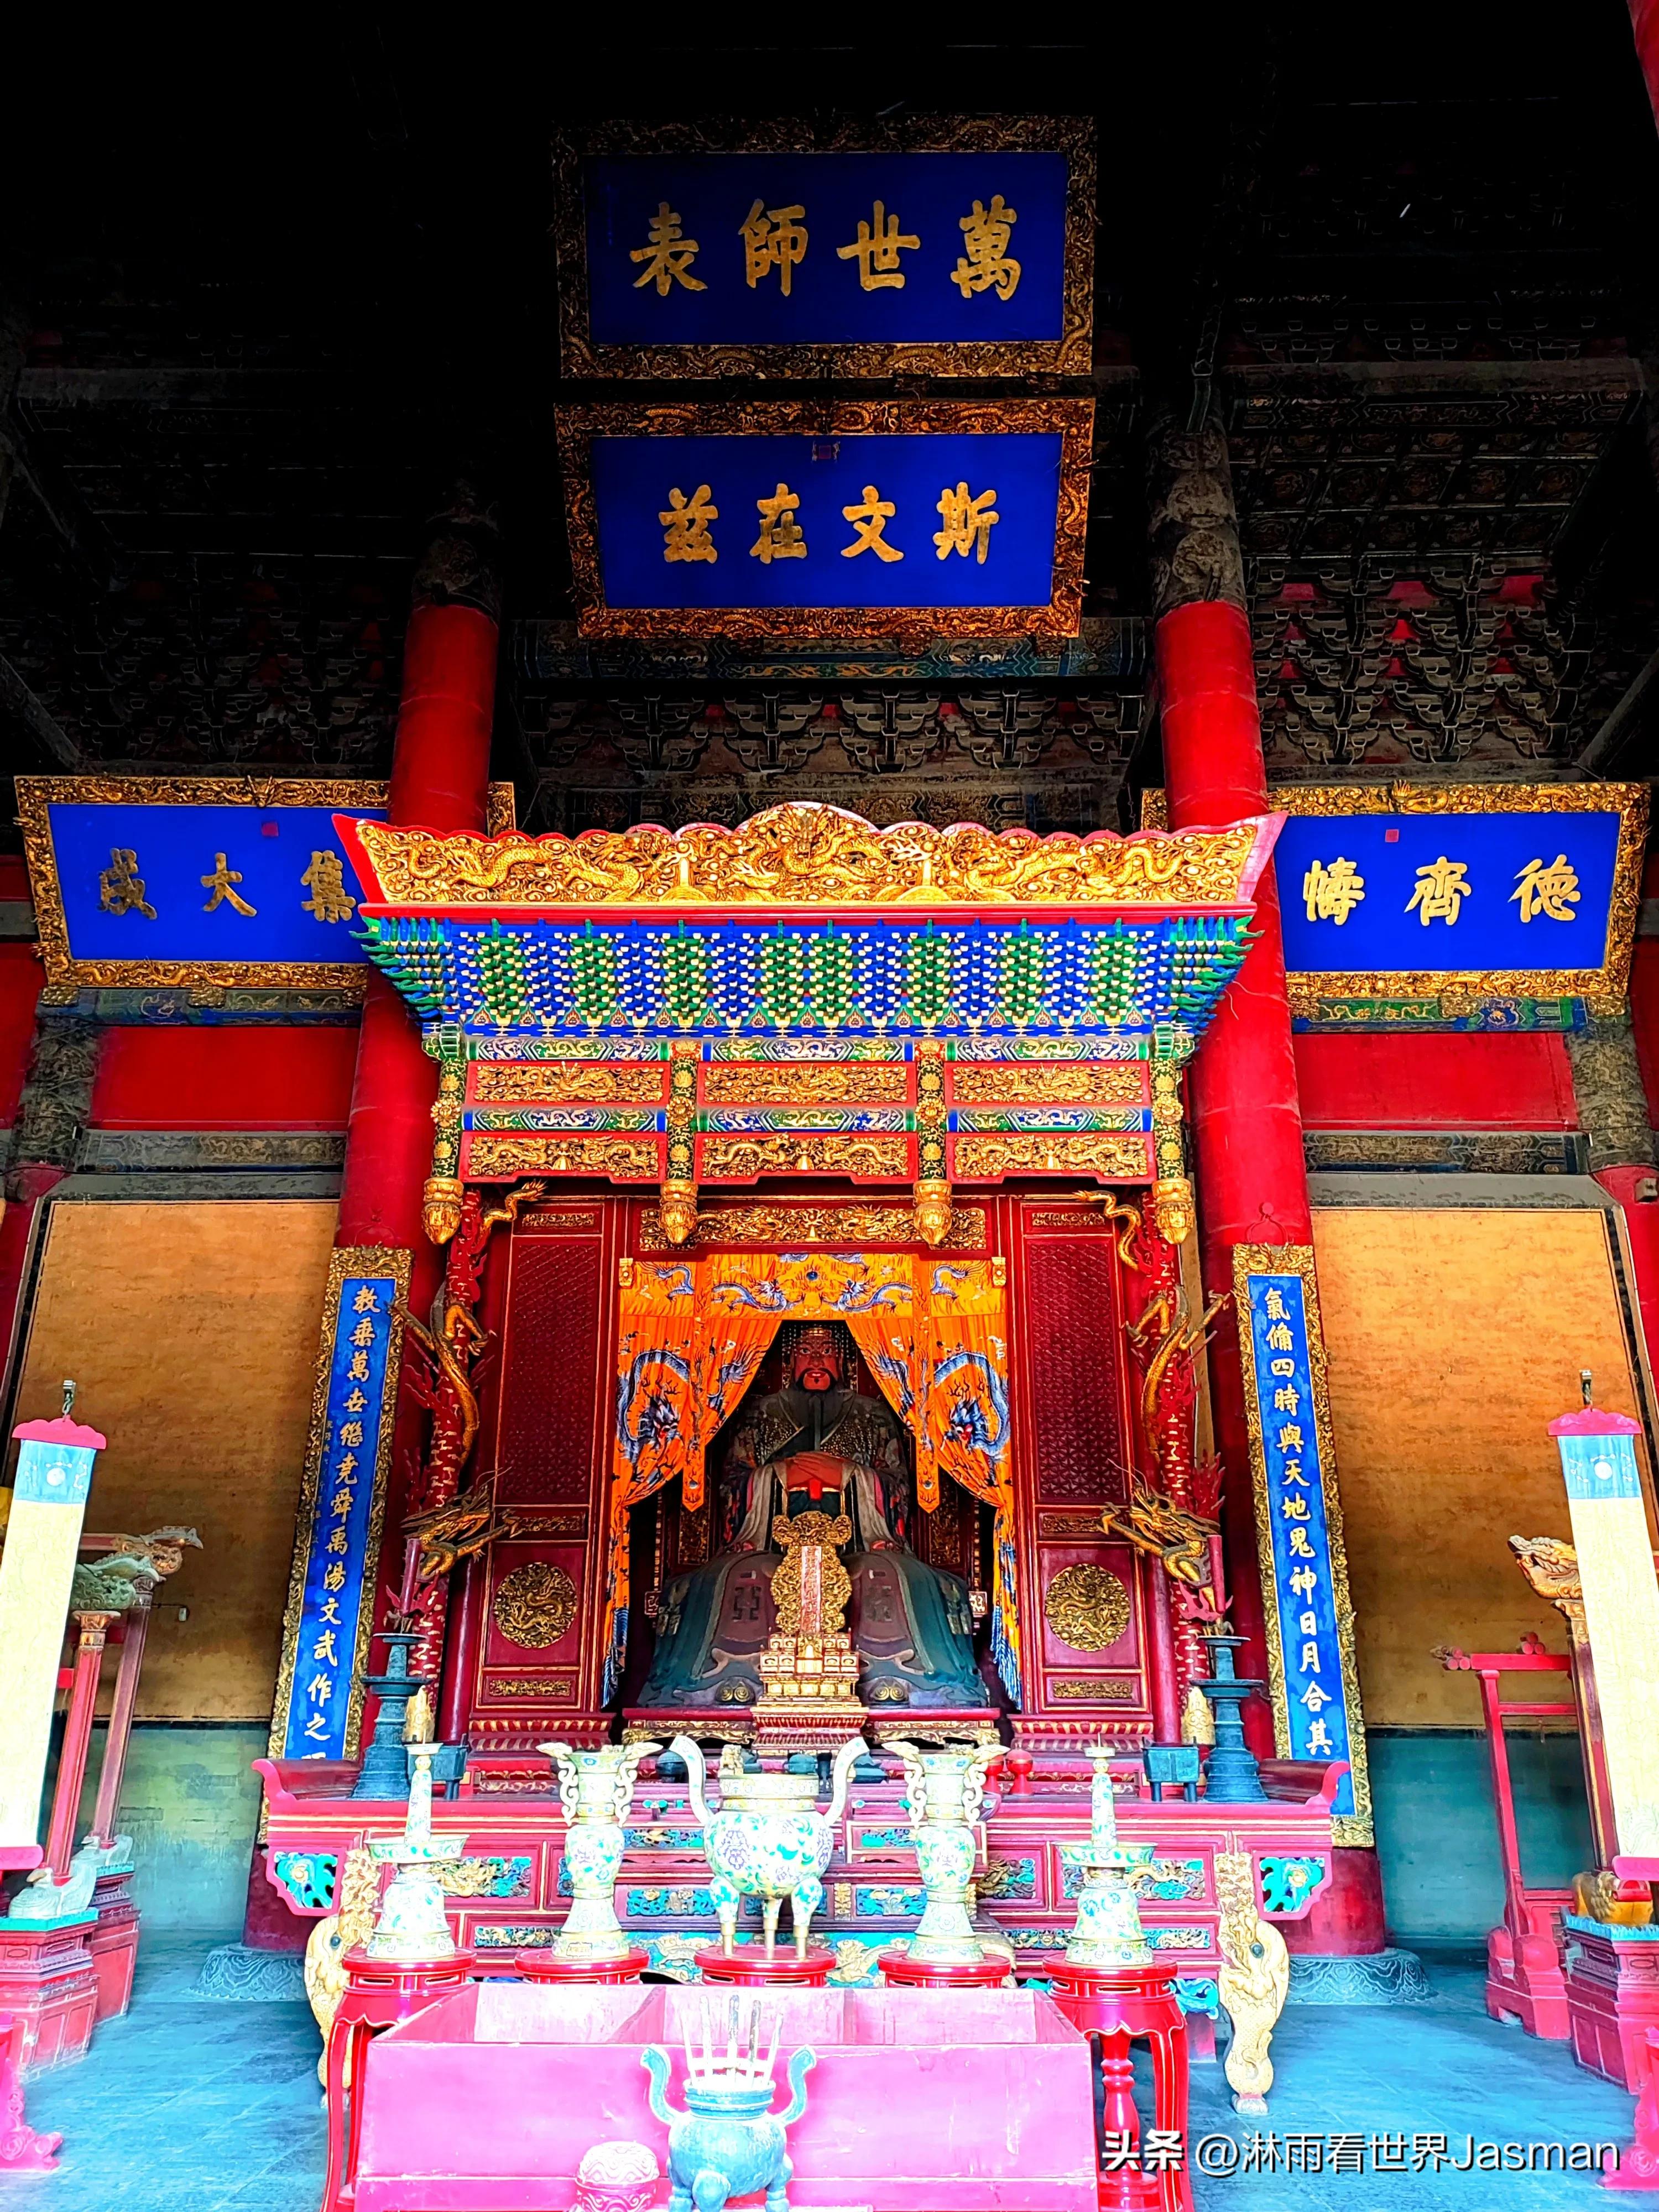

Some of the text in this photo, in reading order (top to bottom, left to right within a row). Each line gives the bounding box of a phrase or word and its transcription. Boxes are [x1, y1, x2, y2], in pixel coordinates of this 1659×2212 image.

[630, 194, 1021, 301] 萬世師表
[301, 1285, 381, 1760] 教垂萬世繼堯舜禹湯文武作之
